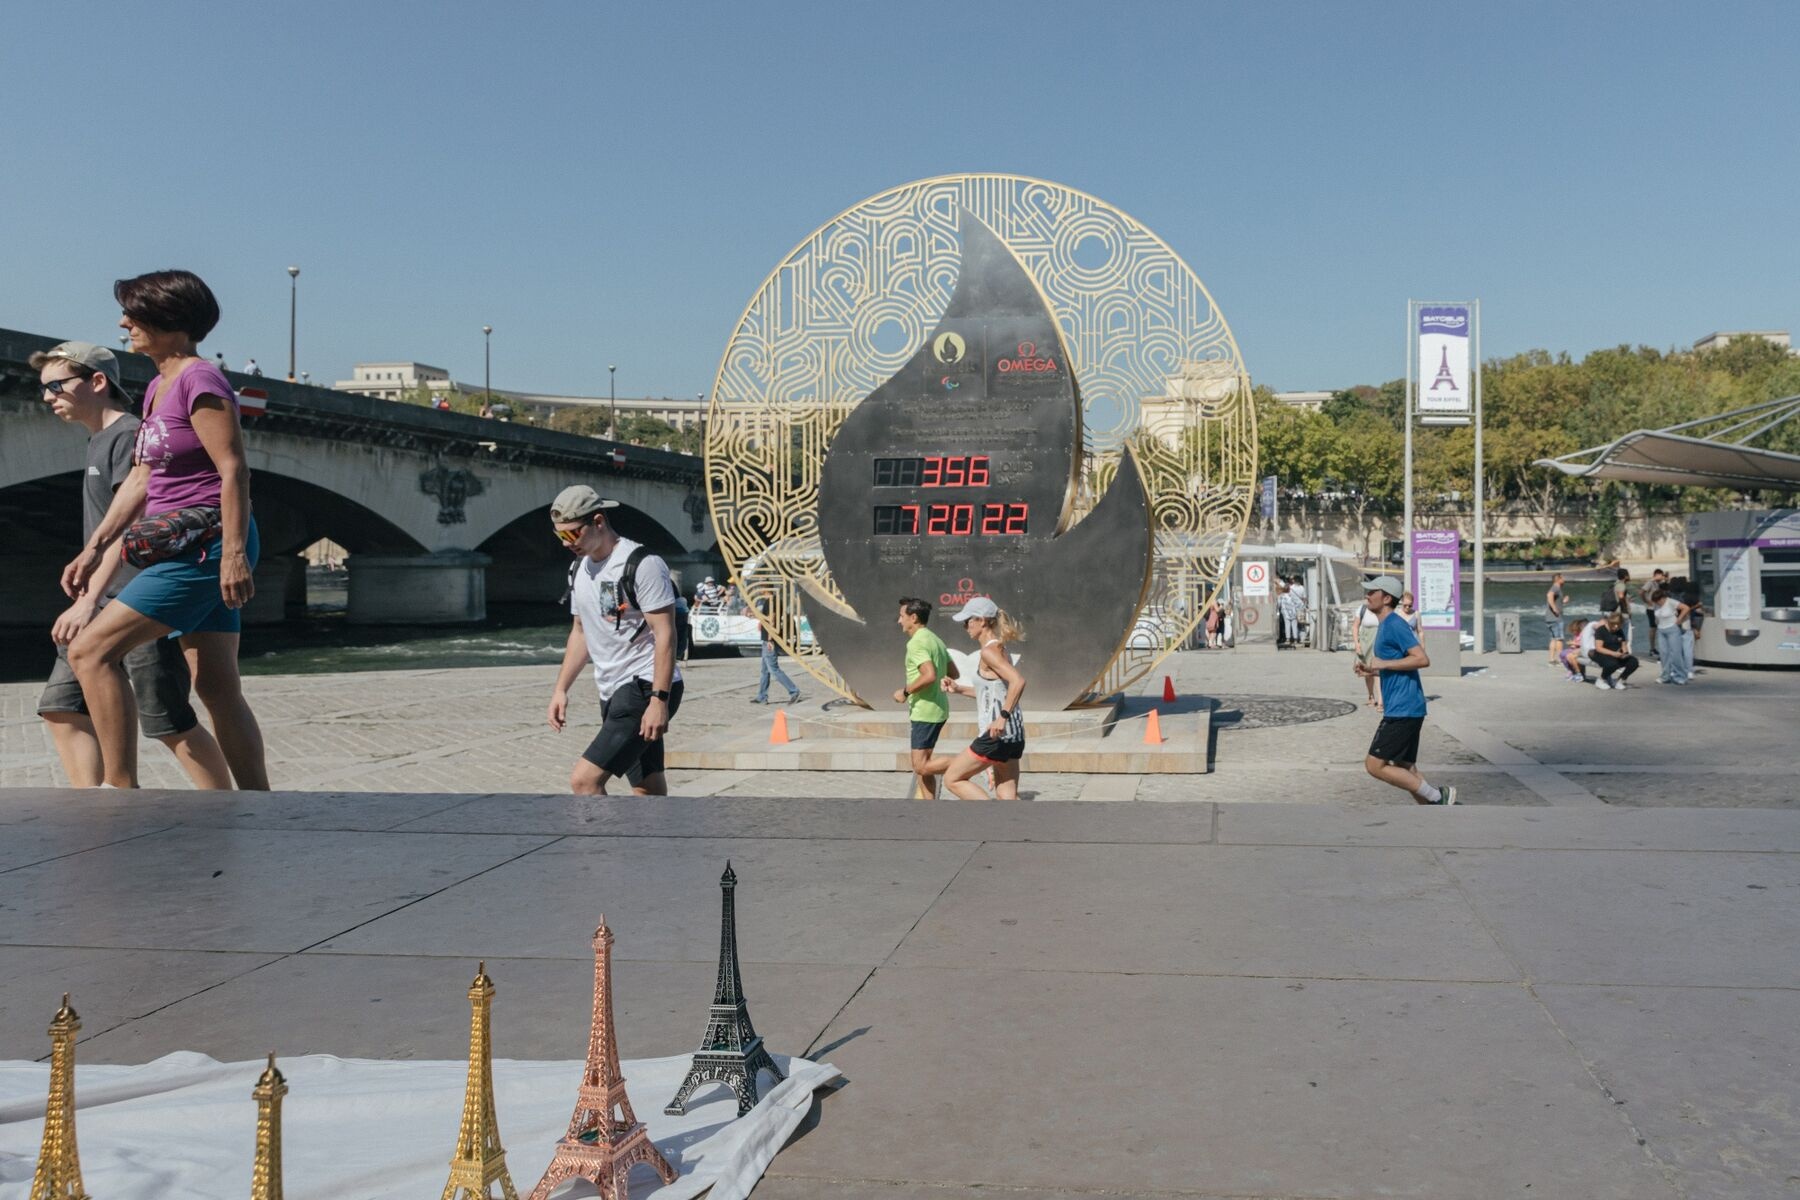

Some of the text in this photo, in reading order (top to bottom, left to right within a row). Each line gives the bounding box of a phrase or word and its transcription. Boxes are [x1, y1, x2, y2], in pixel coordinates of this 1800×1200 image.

[997, 358, 1057, 372] OMEGA
[922, 456, 990, 487] 356
[900, 503, 1029, 535] 7 20 22
